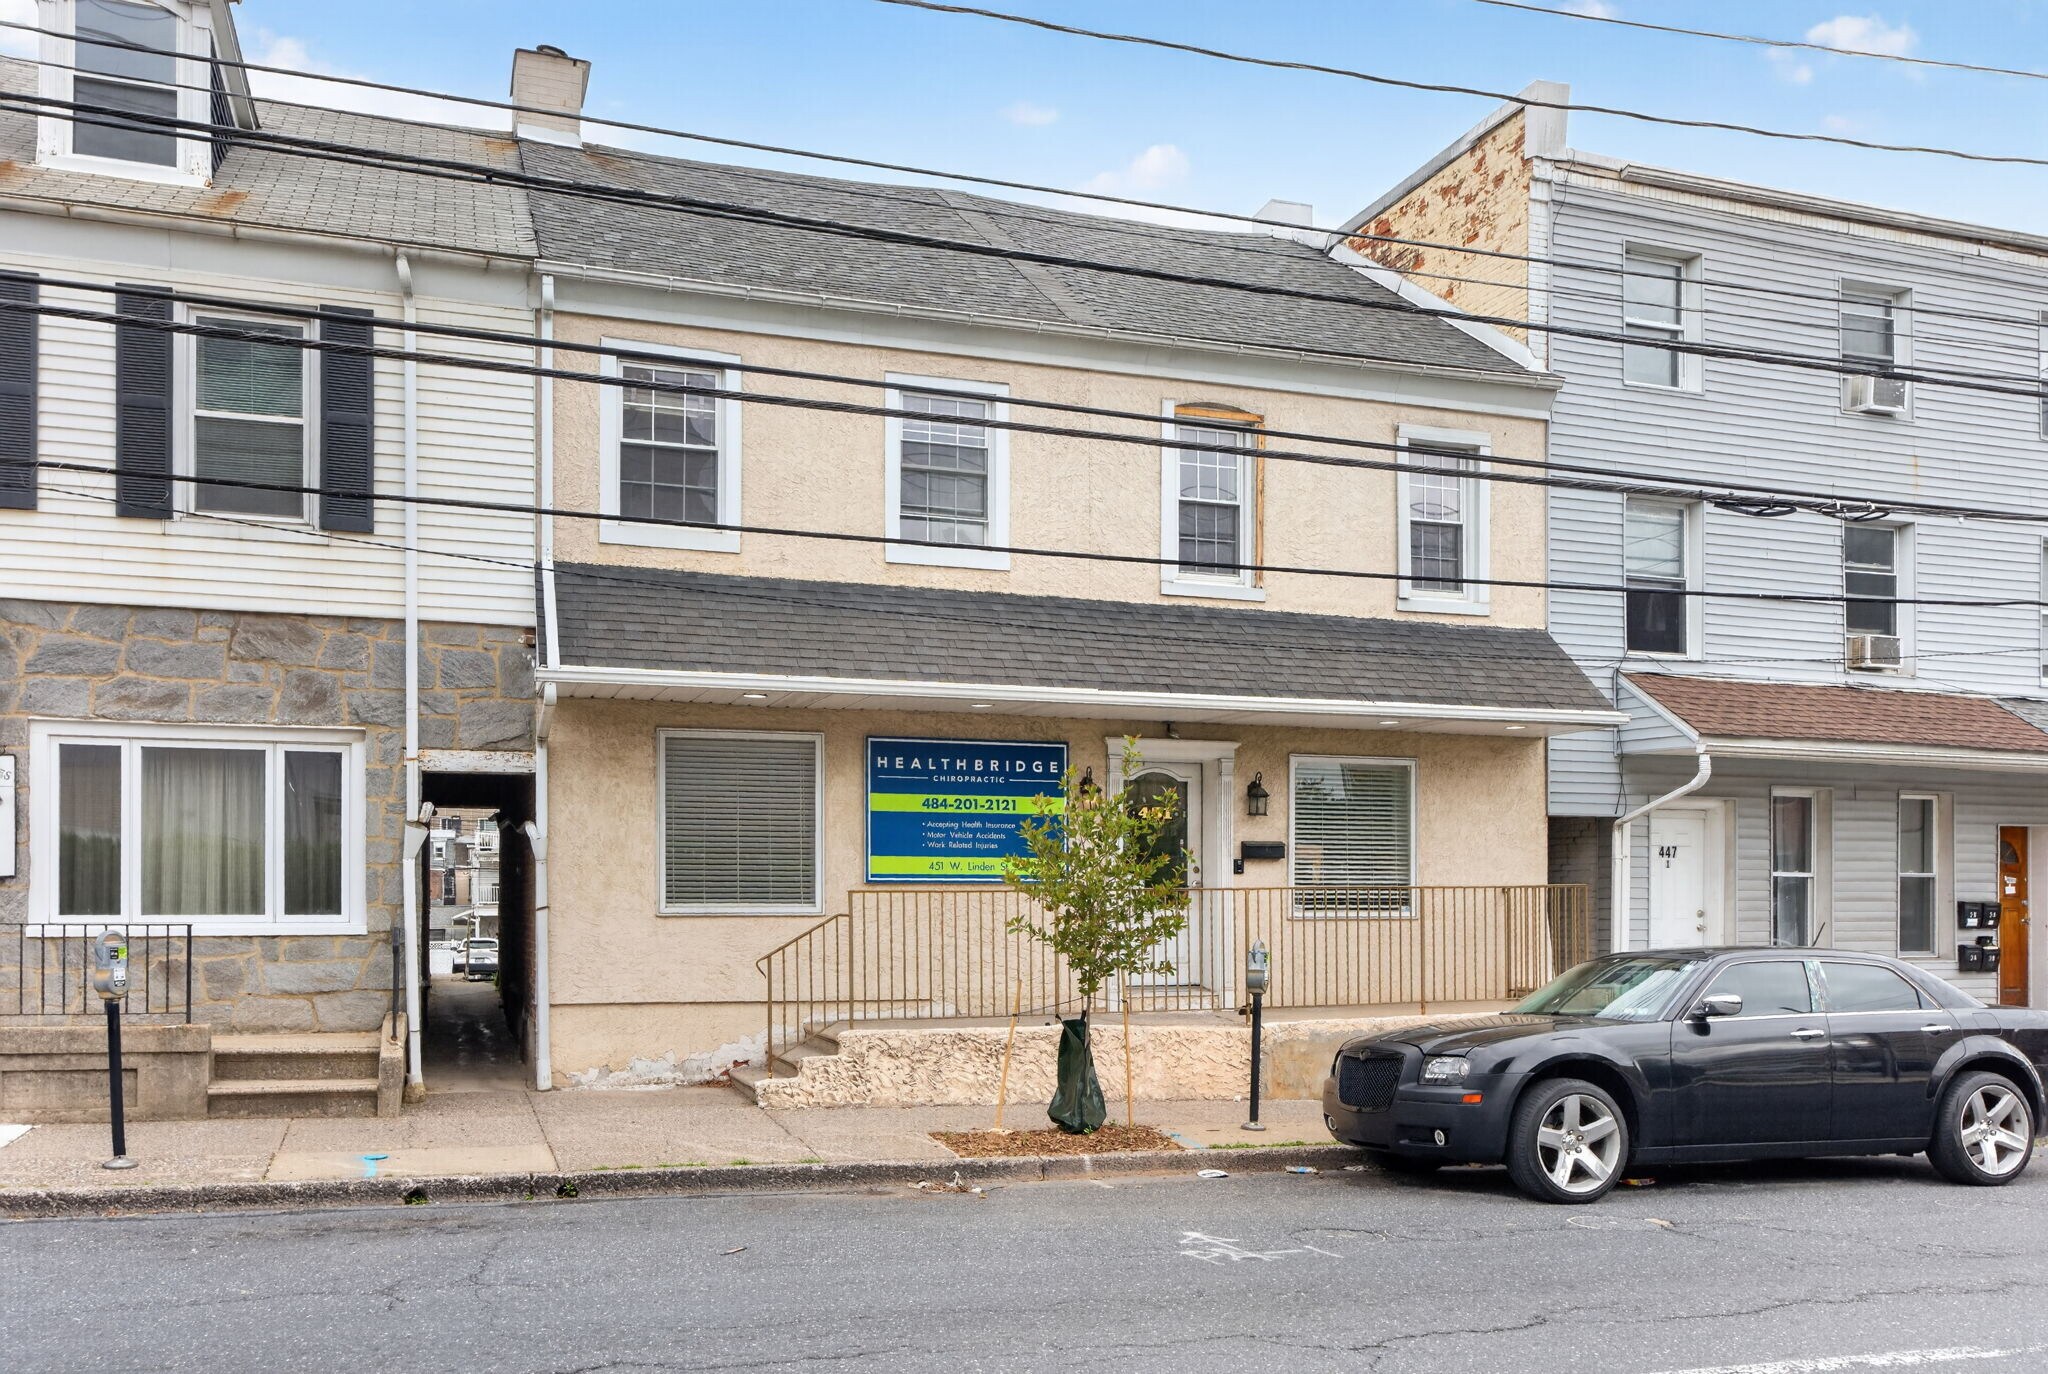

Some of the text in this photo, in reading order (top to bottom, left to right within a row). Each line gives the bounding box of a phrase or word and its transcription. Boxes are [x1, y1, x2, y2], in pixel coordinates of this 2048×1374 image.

[877, 756, 1059, 773] HEALTHBRIDGE
[933, 775, 1005, 784] CHIROPRACTIC
[922, 798, 1017, 811] 484-201-2121
[926, 821, 959, 830] Accepting
[961, 821, 982, 829] Health
[950, 831, 973, 839] Vehicle
[948, 841, 973, 849] Related
[975, 842, 998, 850] Injuries
[1659, 846, 1677, 858] 447
[928, 861, 944, 871] 451
[949, 861, 963, 871] W.
[967, 861, 995, 871] Linden
